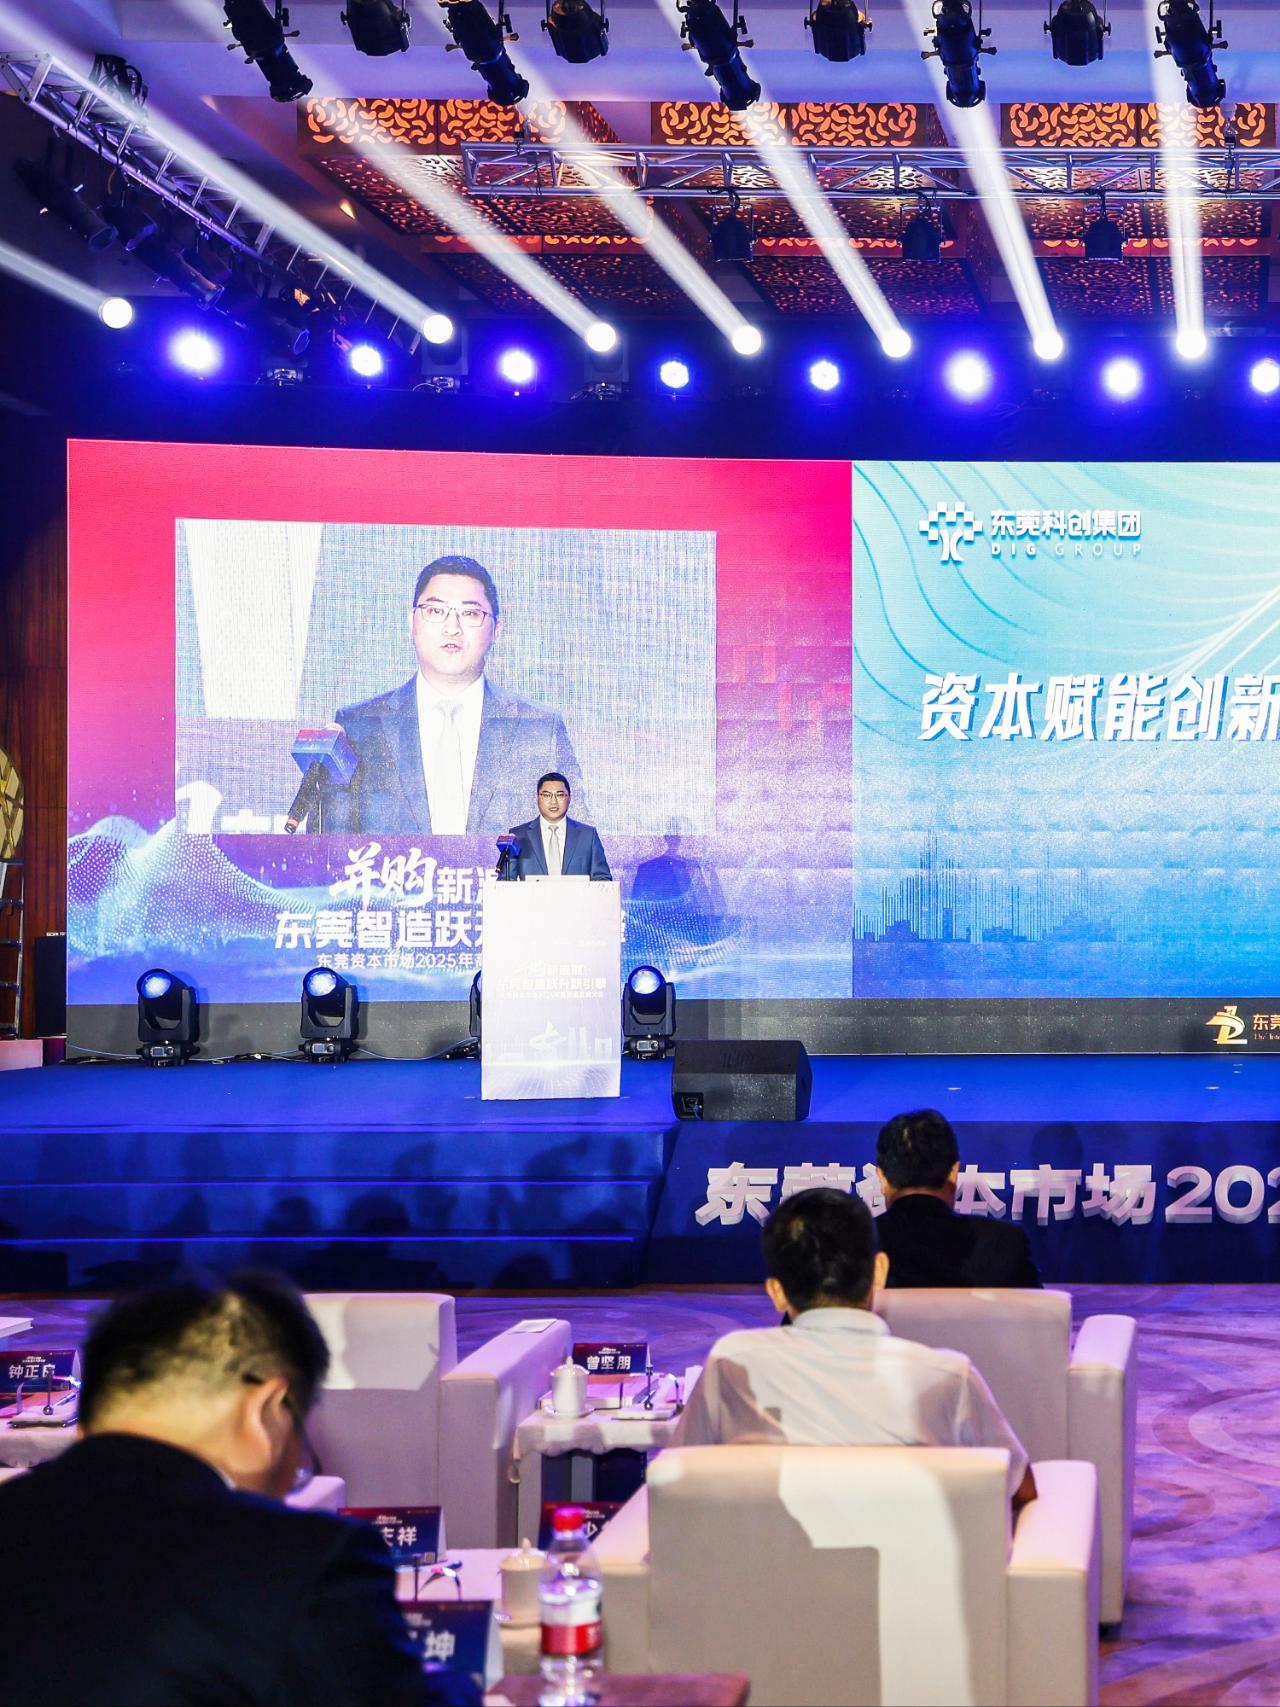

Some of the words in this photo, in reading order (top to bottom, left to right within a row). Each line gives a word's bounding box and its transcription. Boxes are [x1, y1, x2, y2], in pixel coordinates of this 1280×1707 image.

[990, 509, 1141, 539] 东莞科创集团
[991, 542, 1037, 556] DIG
[1055, 542, 1142, 556] GROUP
